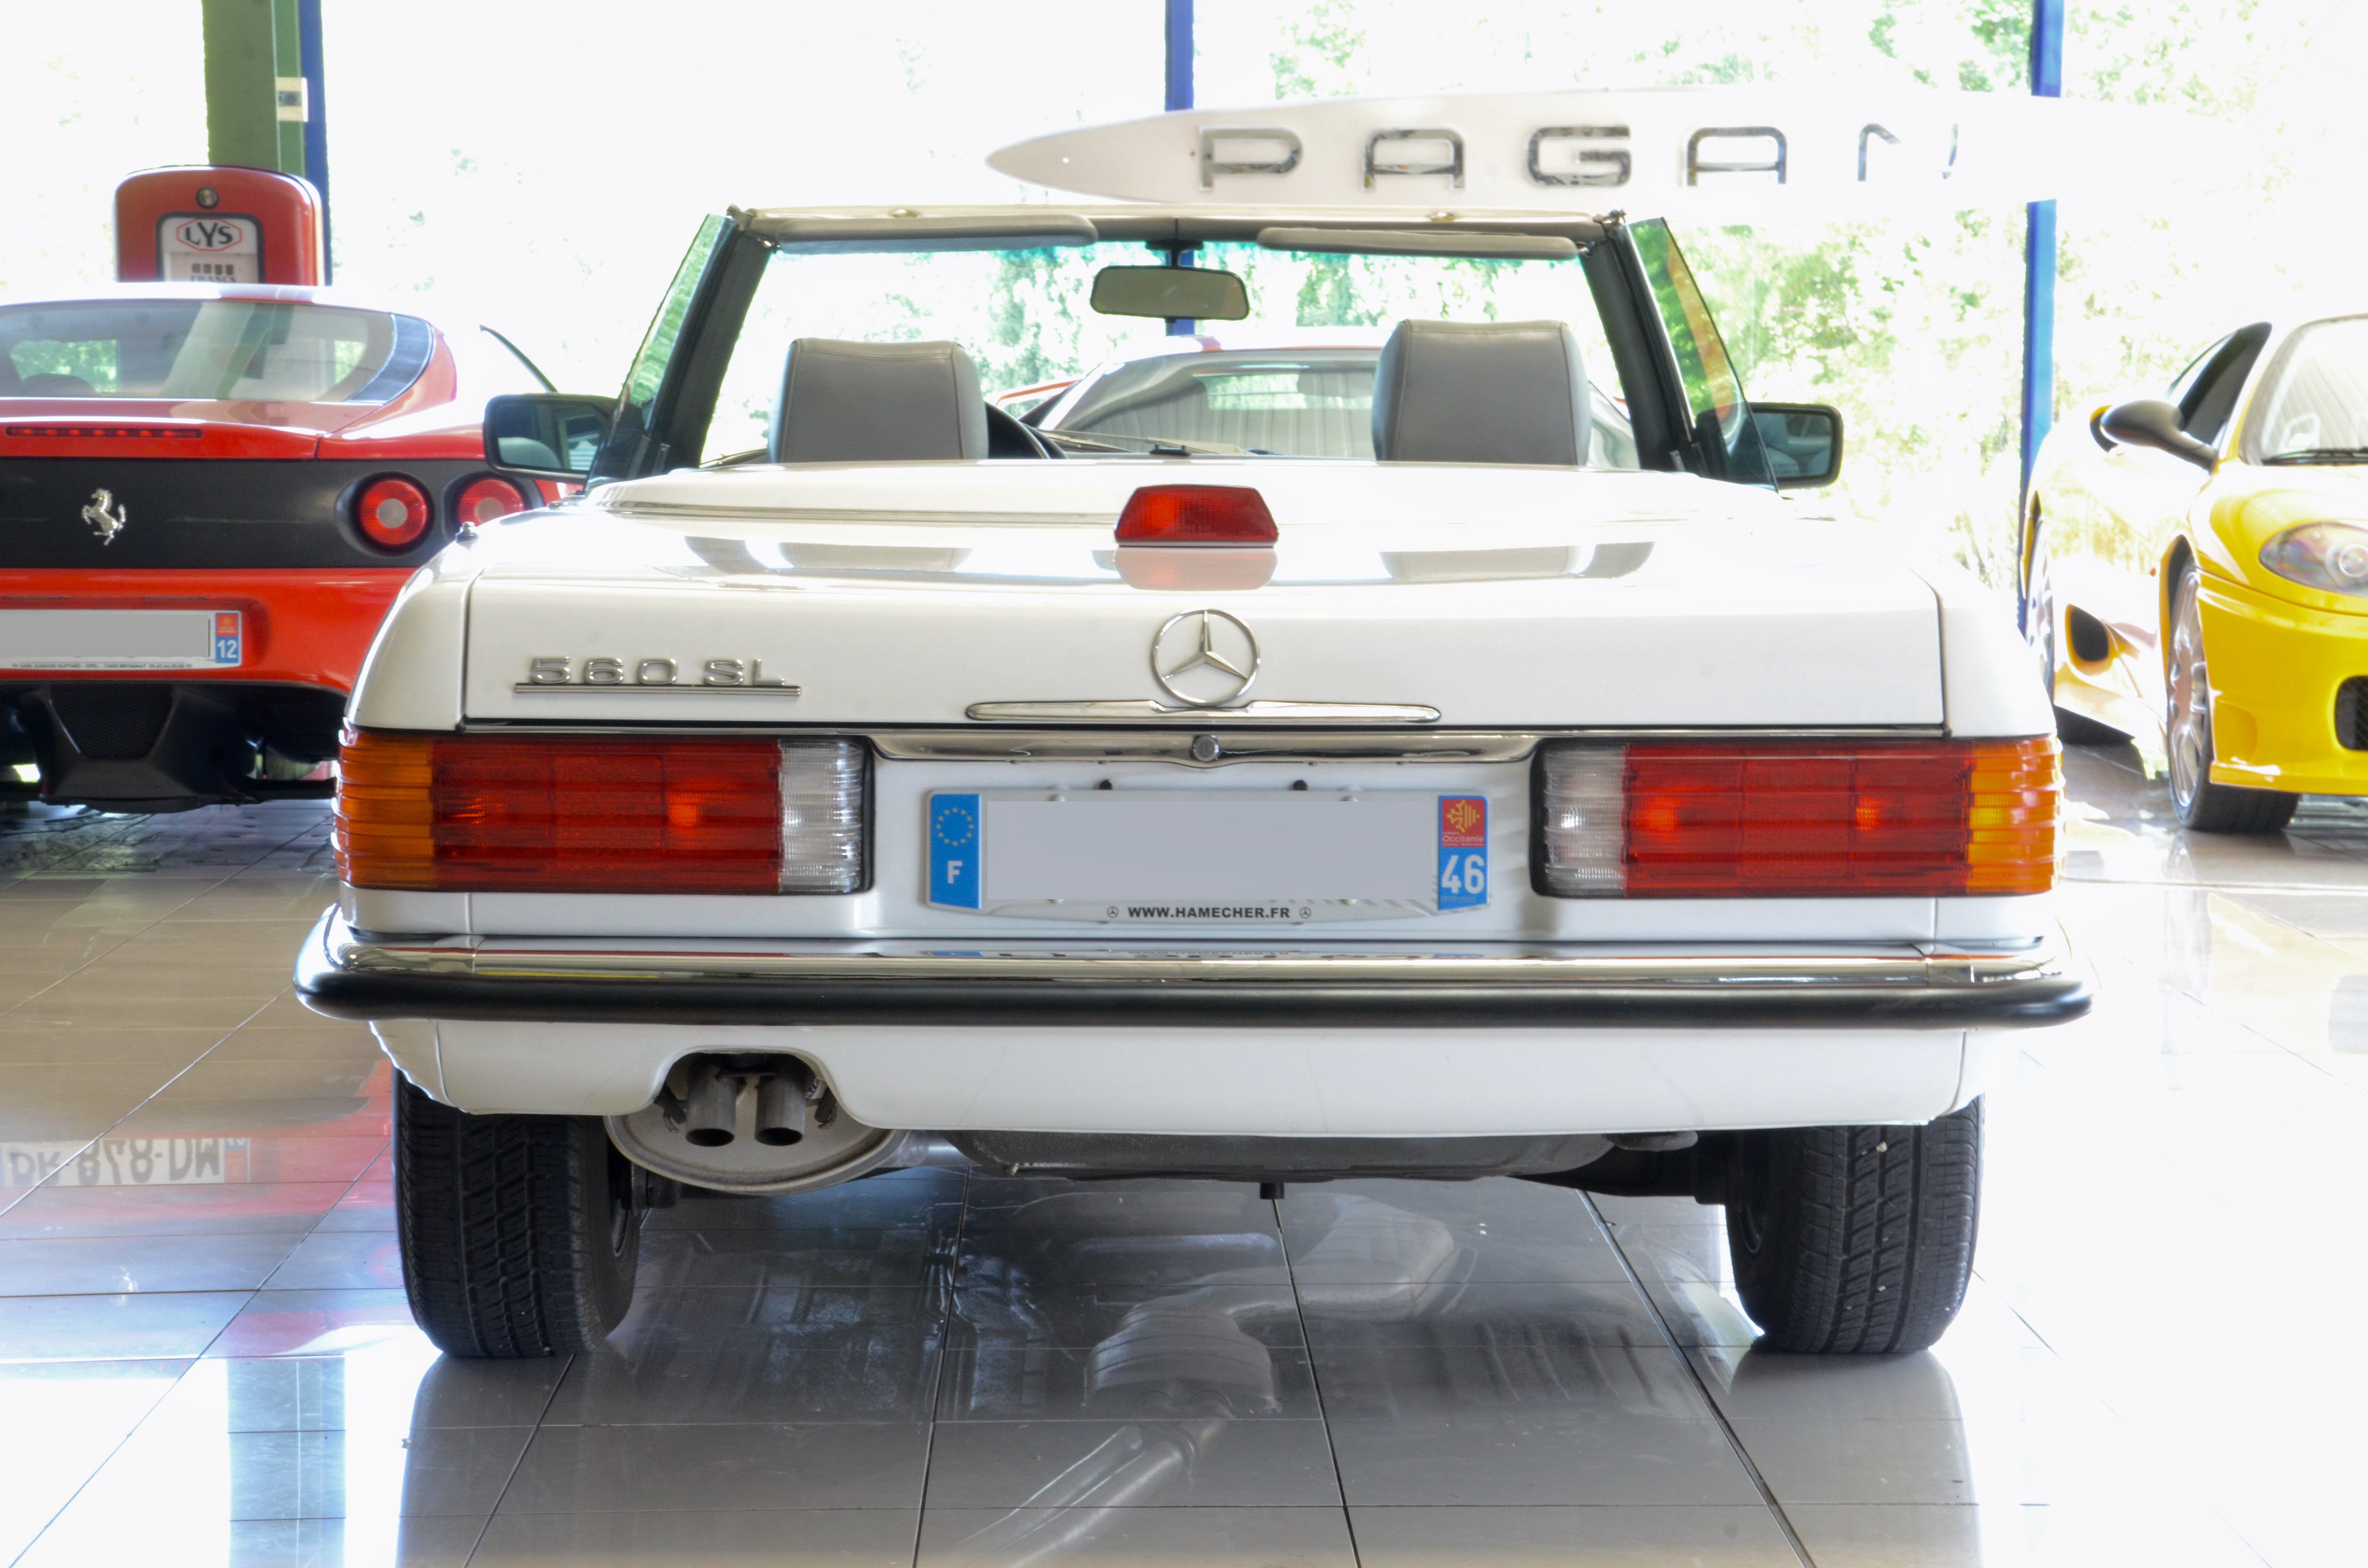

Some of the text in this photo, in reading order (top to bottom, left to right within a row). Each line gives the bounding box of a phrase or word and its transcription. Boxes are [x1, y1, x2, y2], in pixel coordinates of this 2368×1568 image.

[185, 221, 233, 247] LYS
[216, 640, 238, 659] 12
[530, 656, 786, 686] 560 SL
[948, 860, 963, 884] F
[1442, 854, 1485, 894] 46
[1128, 907, 1291, 918] WWW.HAMECHER.FR
